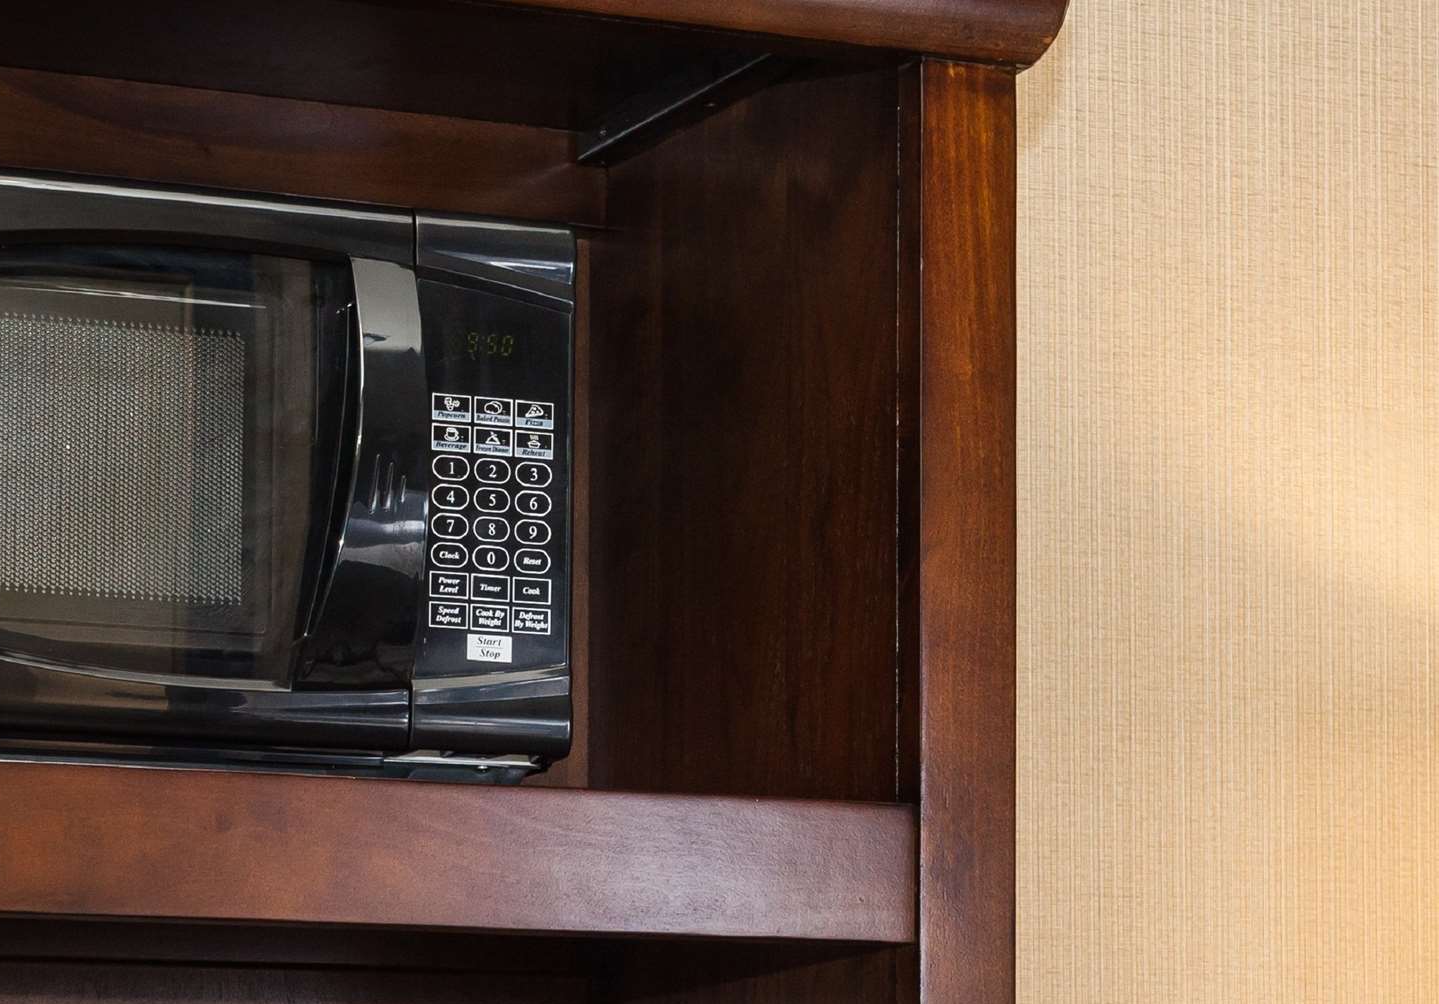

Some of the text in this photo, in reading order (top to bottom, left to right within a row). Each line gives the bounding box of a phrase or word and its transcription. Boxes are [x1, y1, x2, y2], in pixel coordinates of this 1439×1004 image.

[437, 411, 466, 419] Popcorn
[436, 441, 467, 449] Beverage
[449, 462, 454, 474] 1
[489, 465, 497, 478] 2
[530, 468, 538, 481] 3
[446, 490, 455, 503] 4
[489, 494, 496, 506] 5
[529, 497, 538, 510] 6
[447, 520, 454, 533] 7
[488, 523, 496, 535] 8
[529, 526, 537, 539] 9
[439, 551, 460, 559] Clock
[487, 551, 495, 565] 0
[523, 557, 542, 565] Reset
[438, 577, 460, 585] Power
[480, 584, 502, 592] Timer
[522, 587, 540, 595] Cook
[438, 606, 459, 615] Speed
[476, 609, 505, 619] Cook By
[436, 615, 461, 624] Defrost
[519, 612, 544, 620] Defrost
[479, 618, 502, 627] Weight
[515, 620, 548, 630] By Weight
[477, 636, 502, 646] Start
[480, 648, 501, 659] Stop
